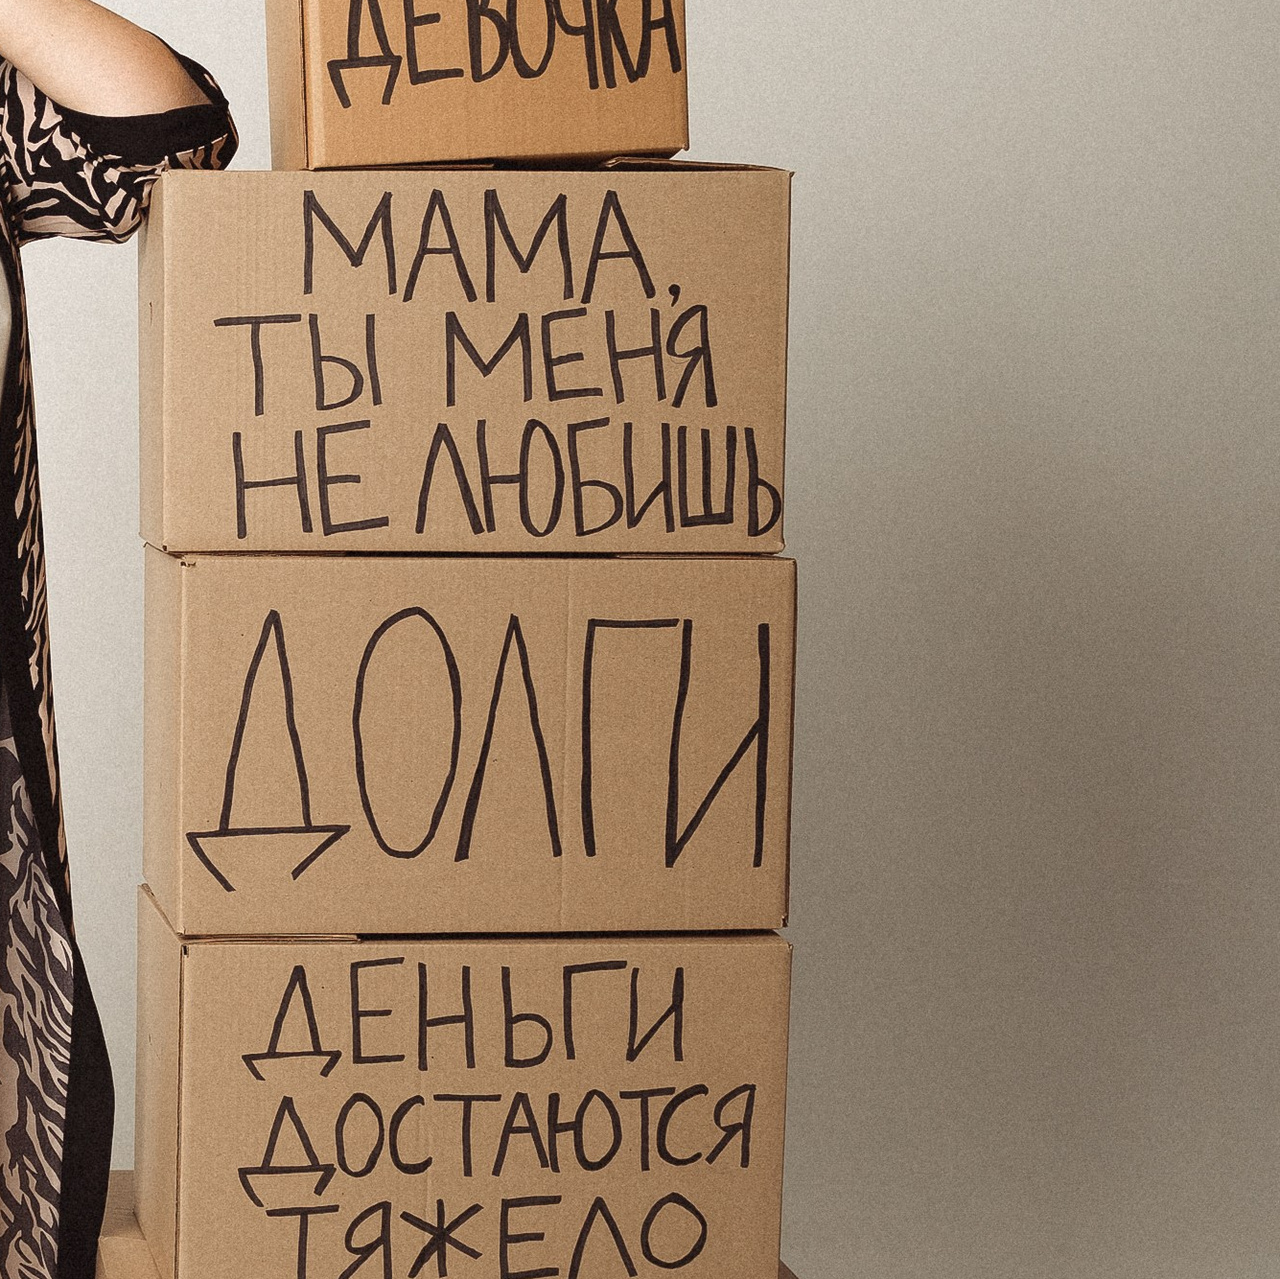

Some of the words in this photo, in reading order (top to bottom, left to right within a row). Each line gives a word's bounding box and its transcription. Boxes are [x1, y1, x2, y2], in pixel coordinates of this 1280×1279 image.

[304, 189, 682, 308] МАМА,
[214, 313, 383, 416] ТЫ
[447, 304, 718, 408] МЕНЯ
[232, 420, 389, 538] НЕ
[416, 417, 782, 538] ЛЮБИШЬ
[186, 607, 770, 892] ДОЛГИ
[242, 957, 684, 1081] ДЕНЬГИ
[238, 1083, 757, 1208] ДОСТАЮТСЯ
